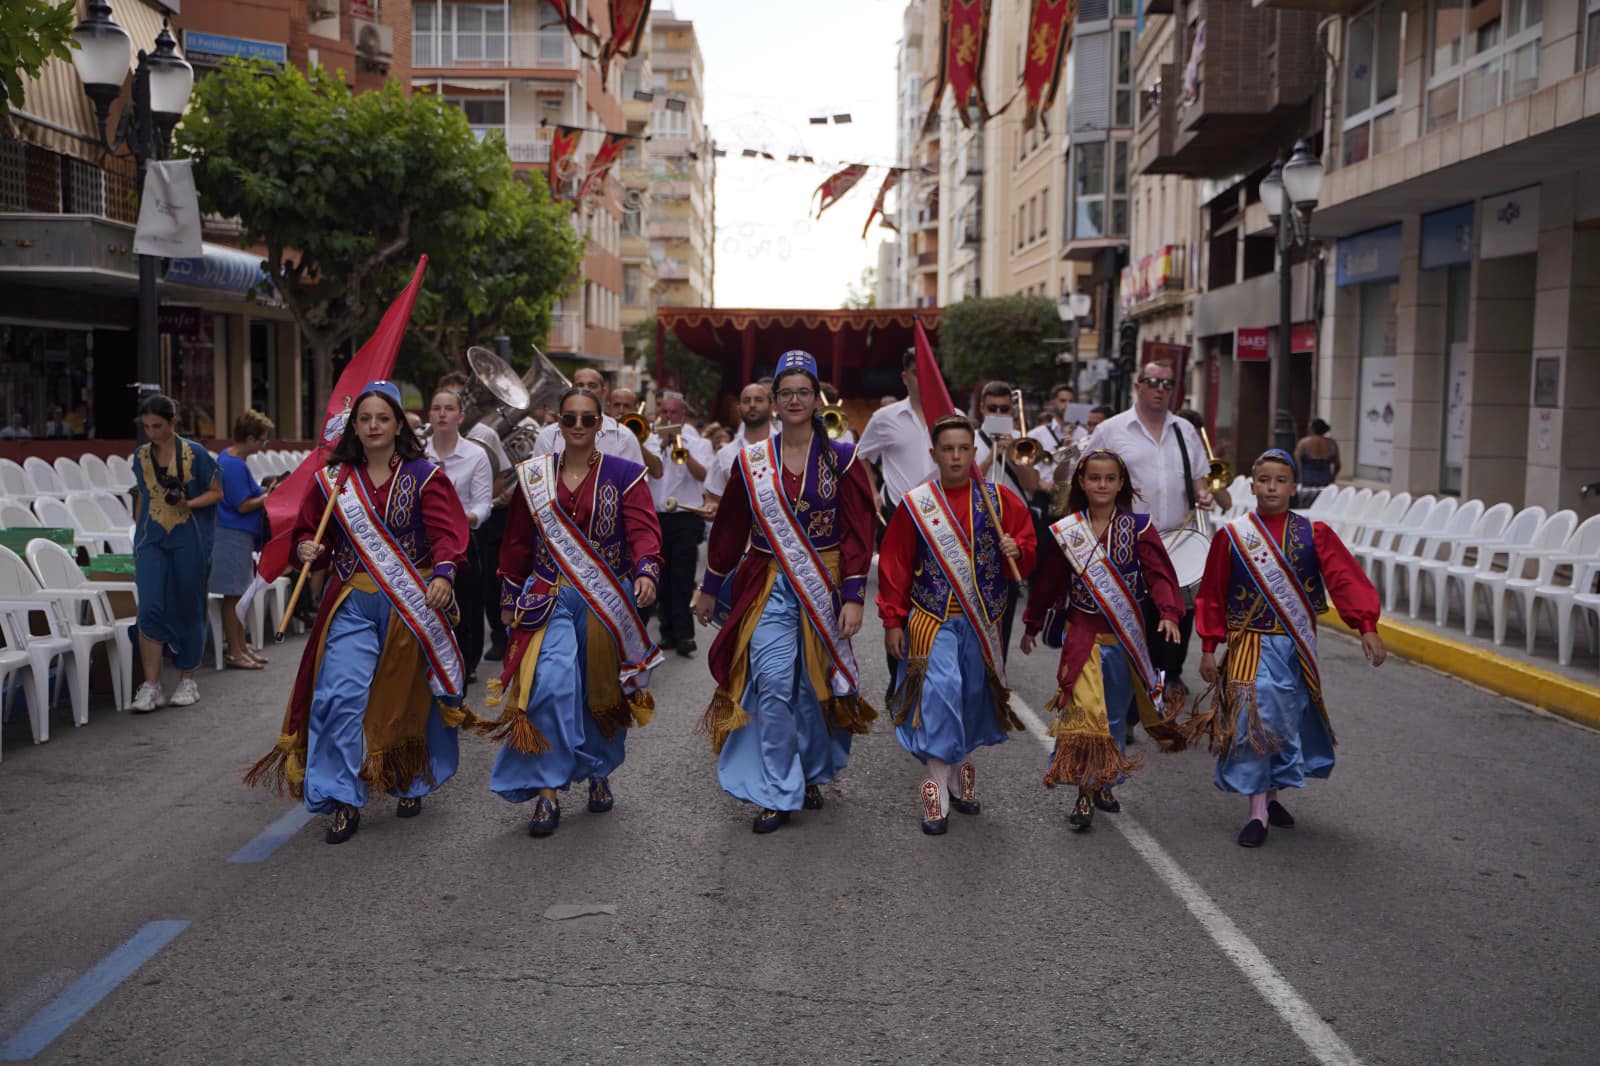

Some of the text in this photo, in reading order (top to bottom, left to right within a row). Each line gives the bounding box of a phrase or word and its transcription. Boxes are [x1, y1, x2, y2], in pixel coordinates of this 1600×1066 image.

[1239, 335, 1266, 347] GAES
[344, 502, 390, 563] Moros
[757, 487, 793, 548] Moros
[540, 508, 583, 564] Moros
[581, 562, 634, 641] Realistas
[936, 531, 972, 587] Moros
[1088, 563, 1124, 608] Moros
[1264, 567, 1299, 617] Moros
